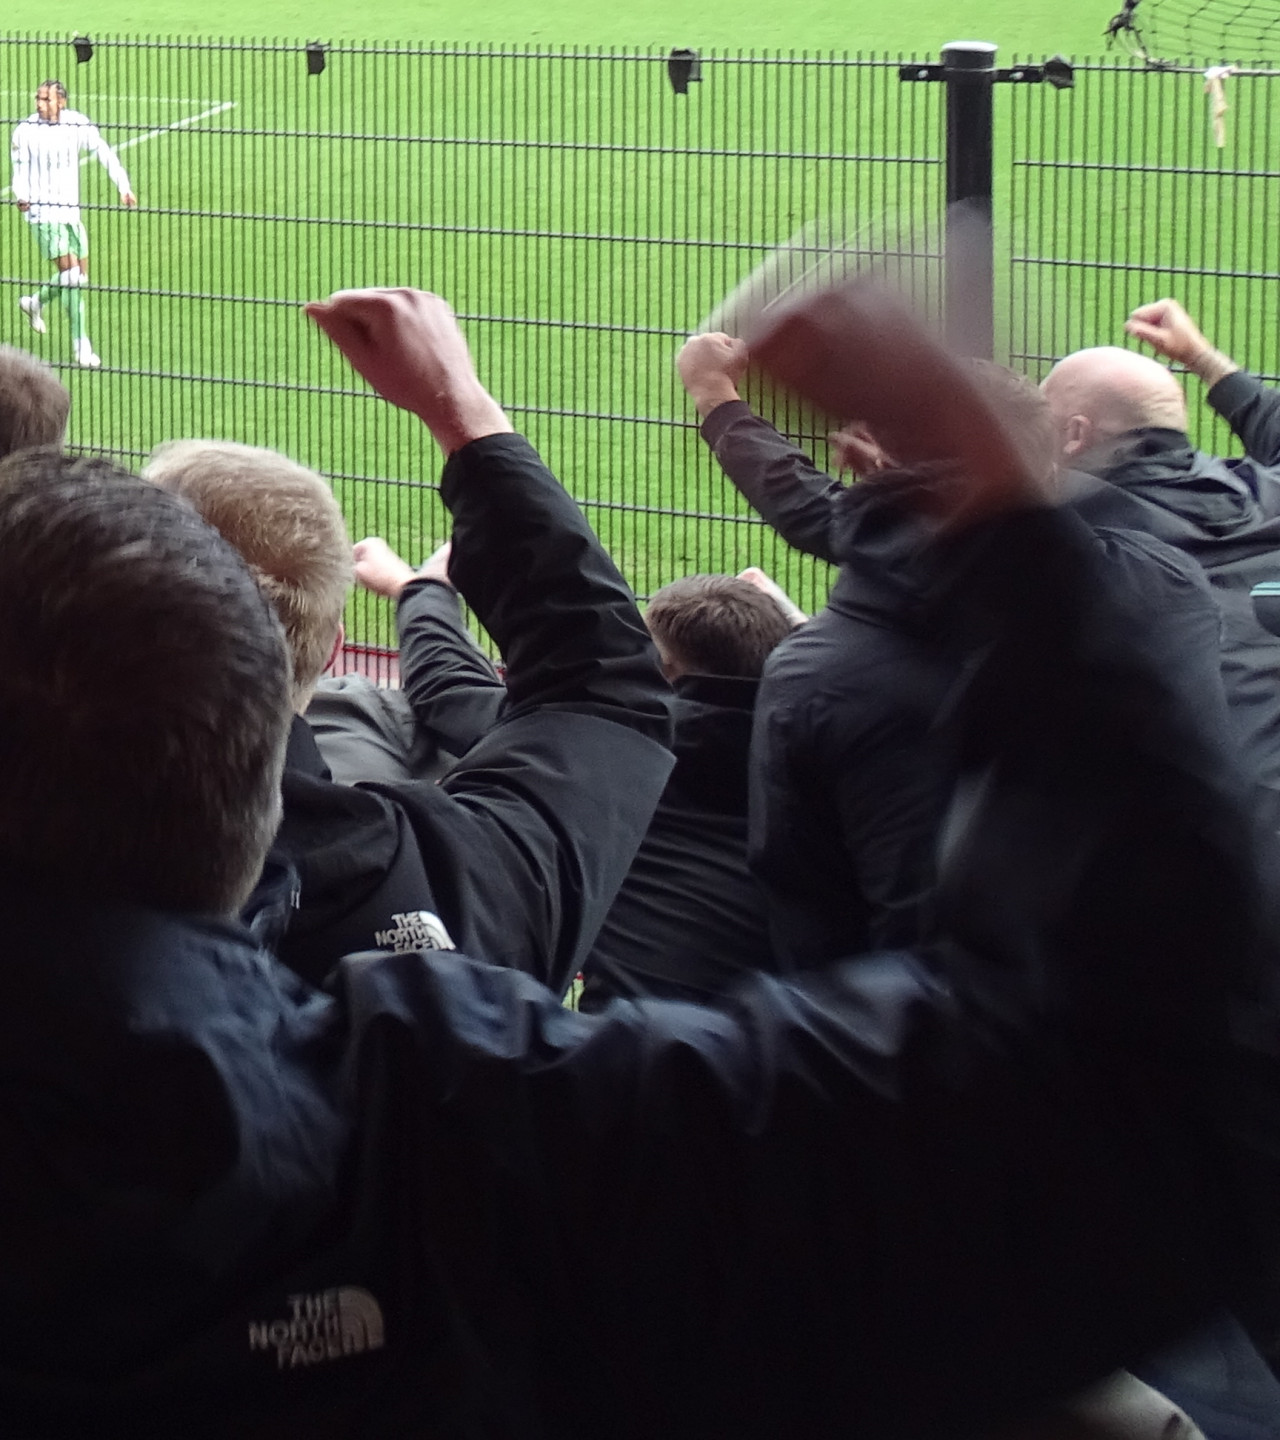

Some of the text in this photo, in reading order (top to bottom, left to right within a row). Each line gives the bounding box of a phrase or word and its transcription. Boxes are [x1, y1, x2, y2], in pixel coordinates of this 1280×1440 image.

[391, 911, 422, 929] THE
[374, 926, 427, 947] NORTH
[394, 939, 432, 953] FACE
